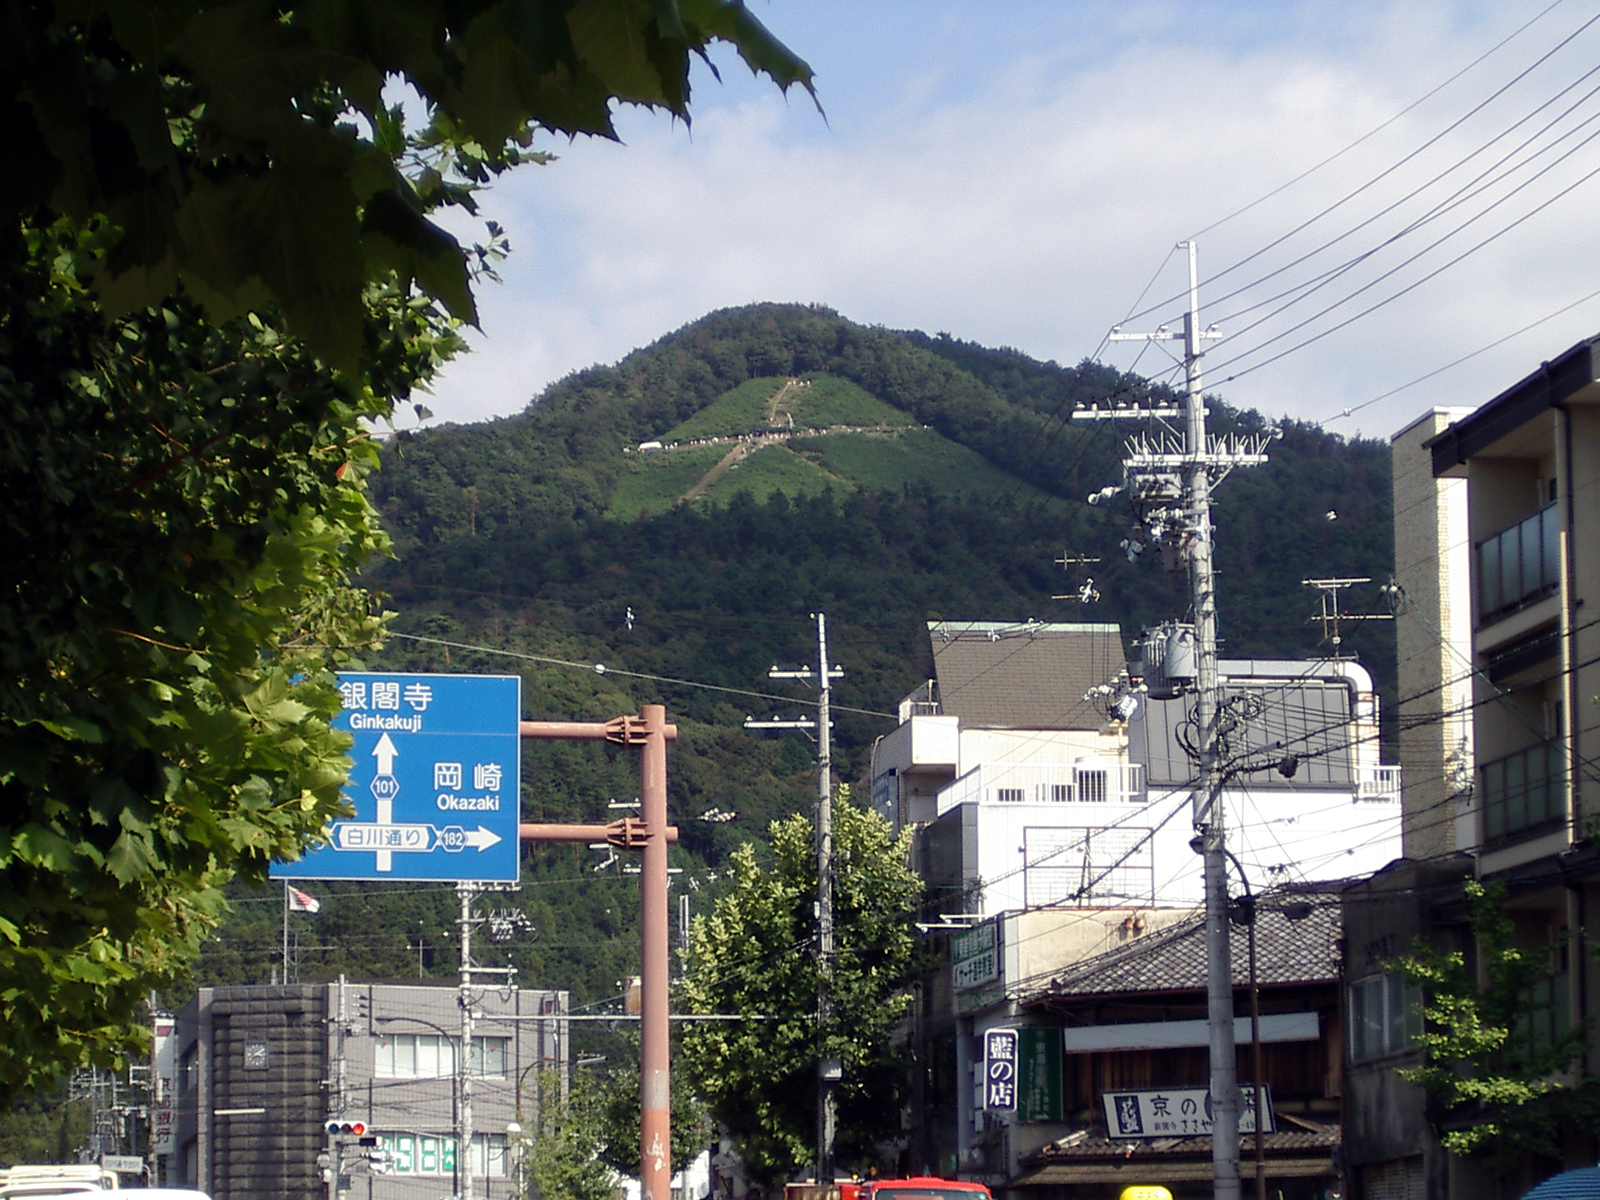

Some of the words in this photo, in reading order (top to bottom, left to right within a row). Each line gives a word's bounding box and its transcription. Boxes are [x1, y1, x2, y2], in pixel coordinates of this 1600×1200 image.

[339, 682, 433, 711] 銀閣寺
[350, 714, 422, 733] Ginkakuji
[434, 763, 503, 790] 岡崎
[376, 779, 394, 794] 101
[437, 795, 500, 811] Okazaki
[347, 828, 421, 847] 白川通り
[443, 831, 463, 848] 182
[989, 1036, 1014, 1107] 藍の店
